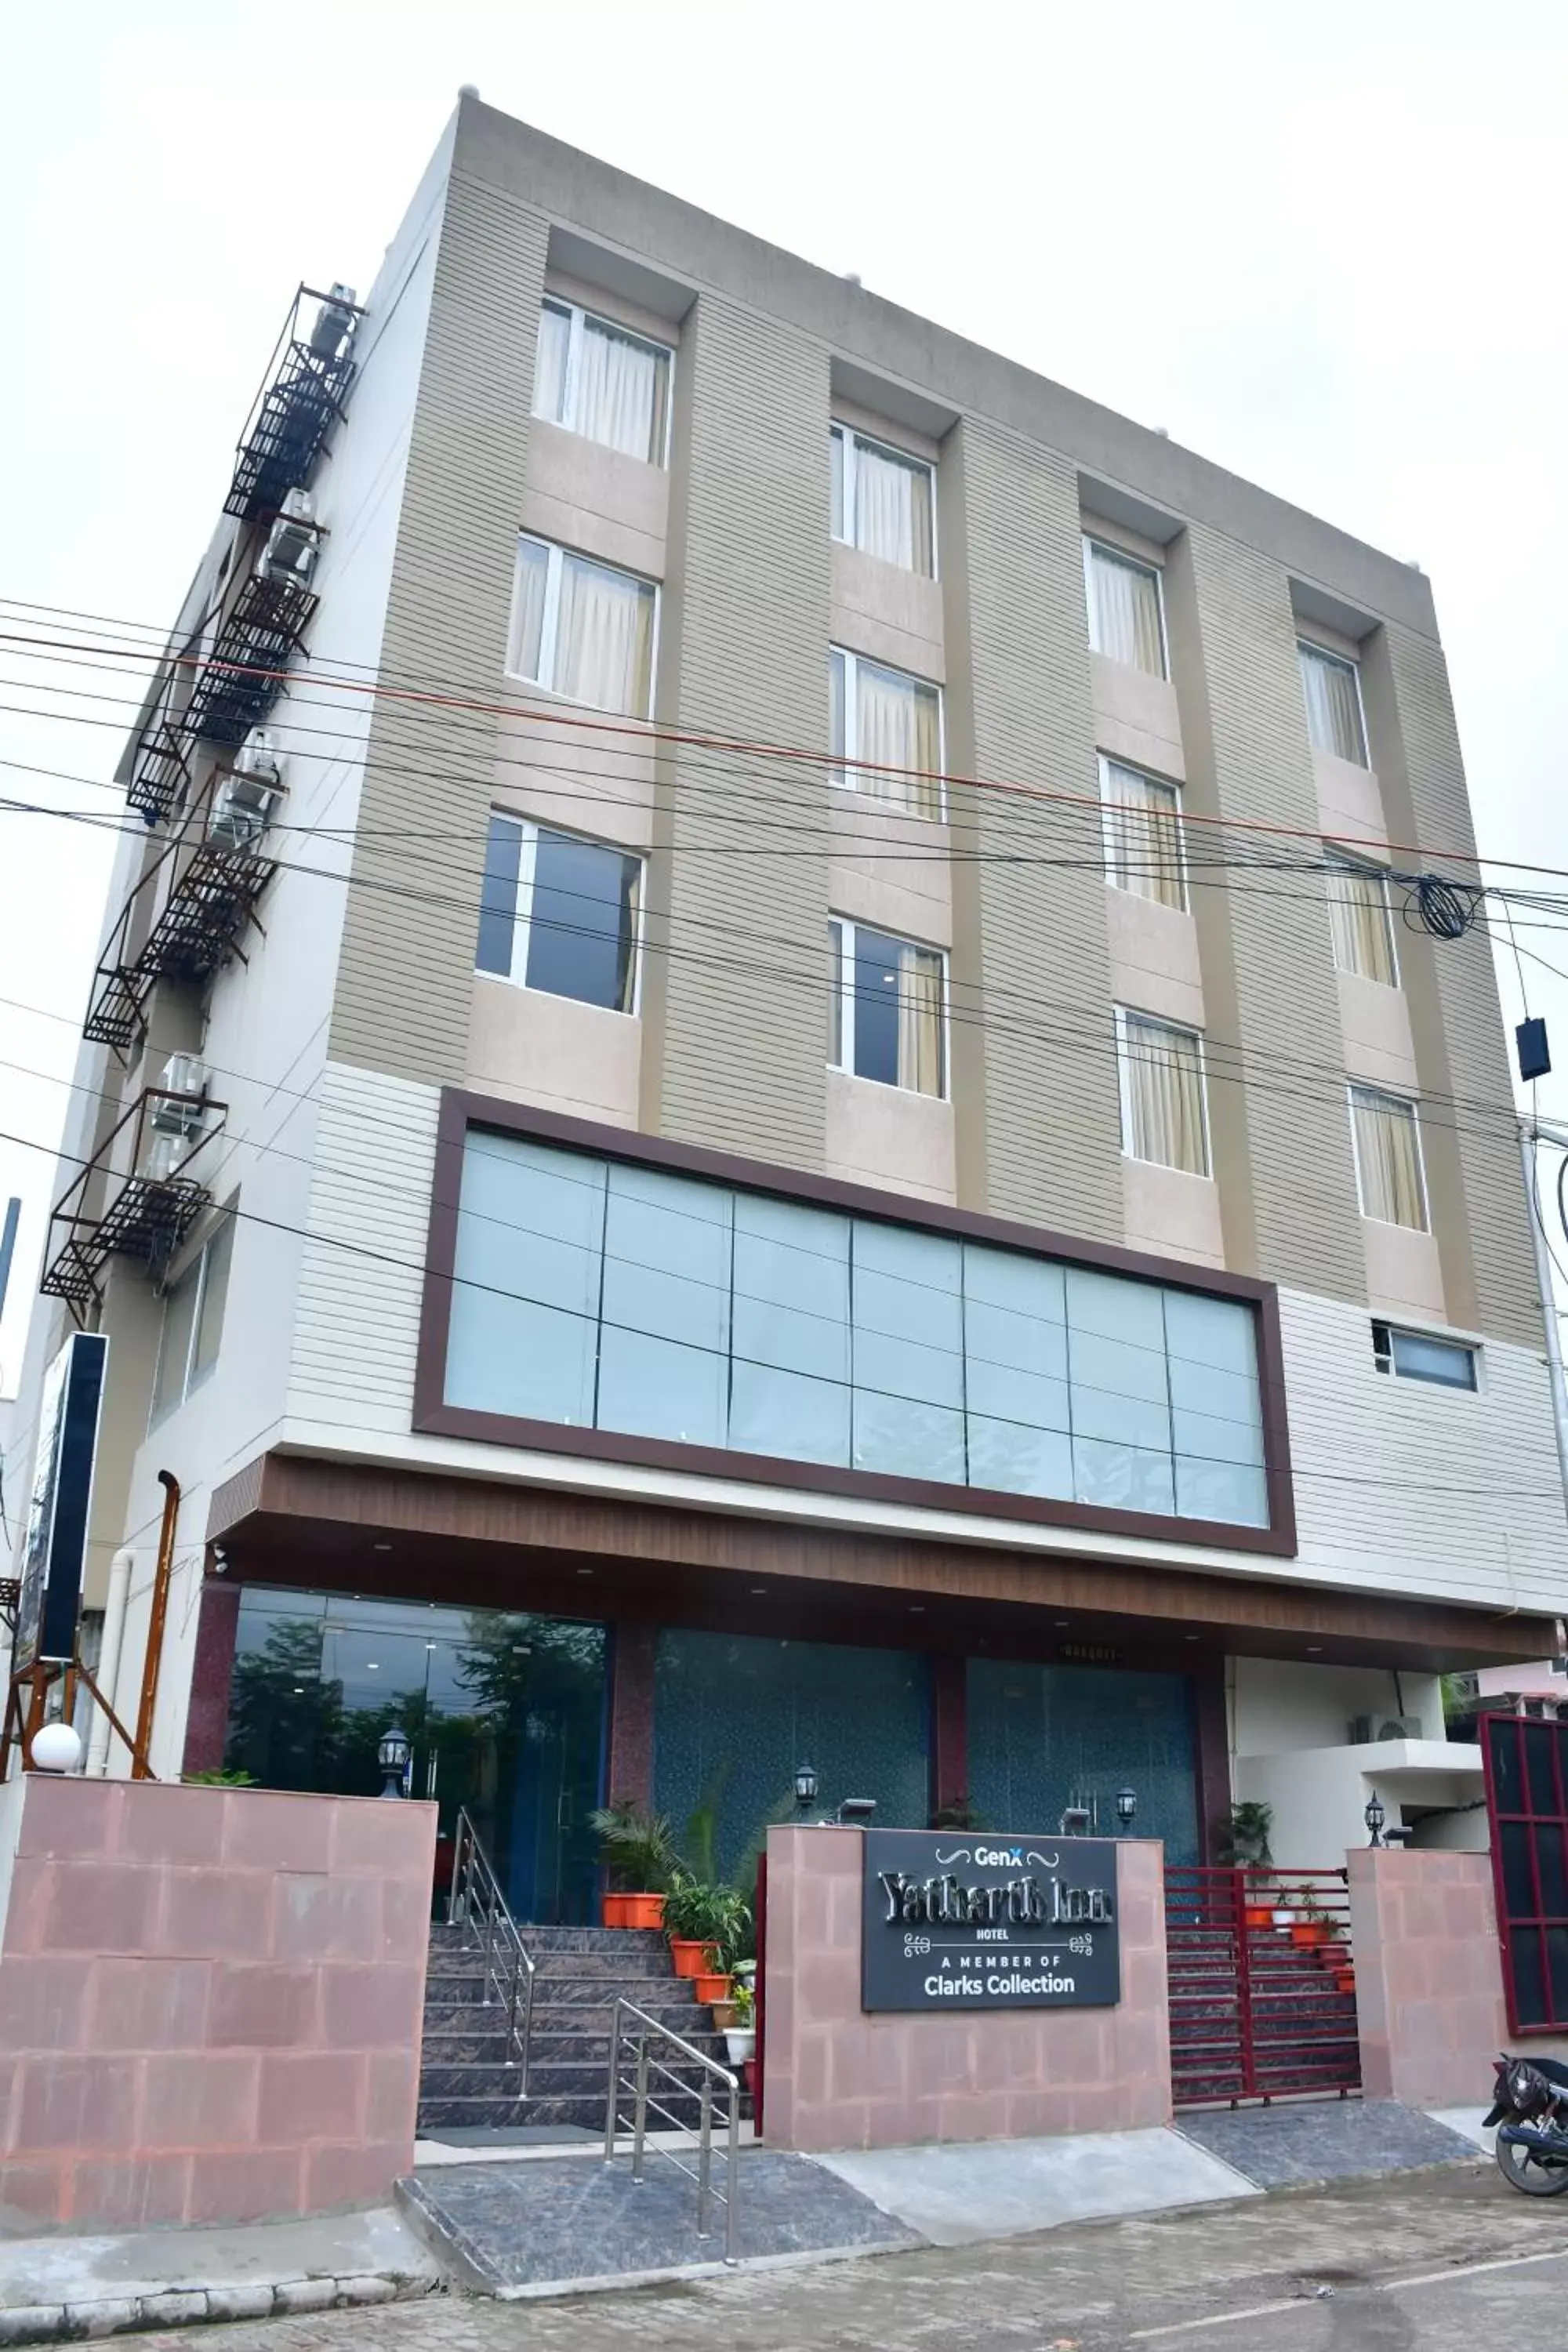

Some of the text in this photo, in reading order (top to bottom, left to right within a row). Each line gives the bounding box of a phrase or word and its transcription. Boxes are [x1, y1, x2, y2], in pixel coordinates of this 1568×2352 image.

[975, 1846, 1023, 1867] GenX
[877, 1871, 1112, 1924] Yatharth Inn
[976, 1929, 1009, 1940] HOTEL
[942, 1957, 1061, 1969] A MEMBER OF
[924, 1973, 1075, 1996] Clarks Collection
